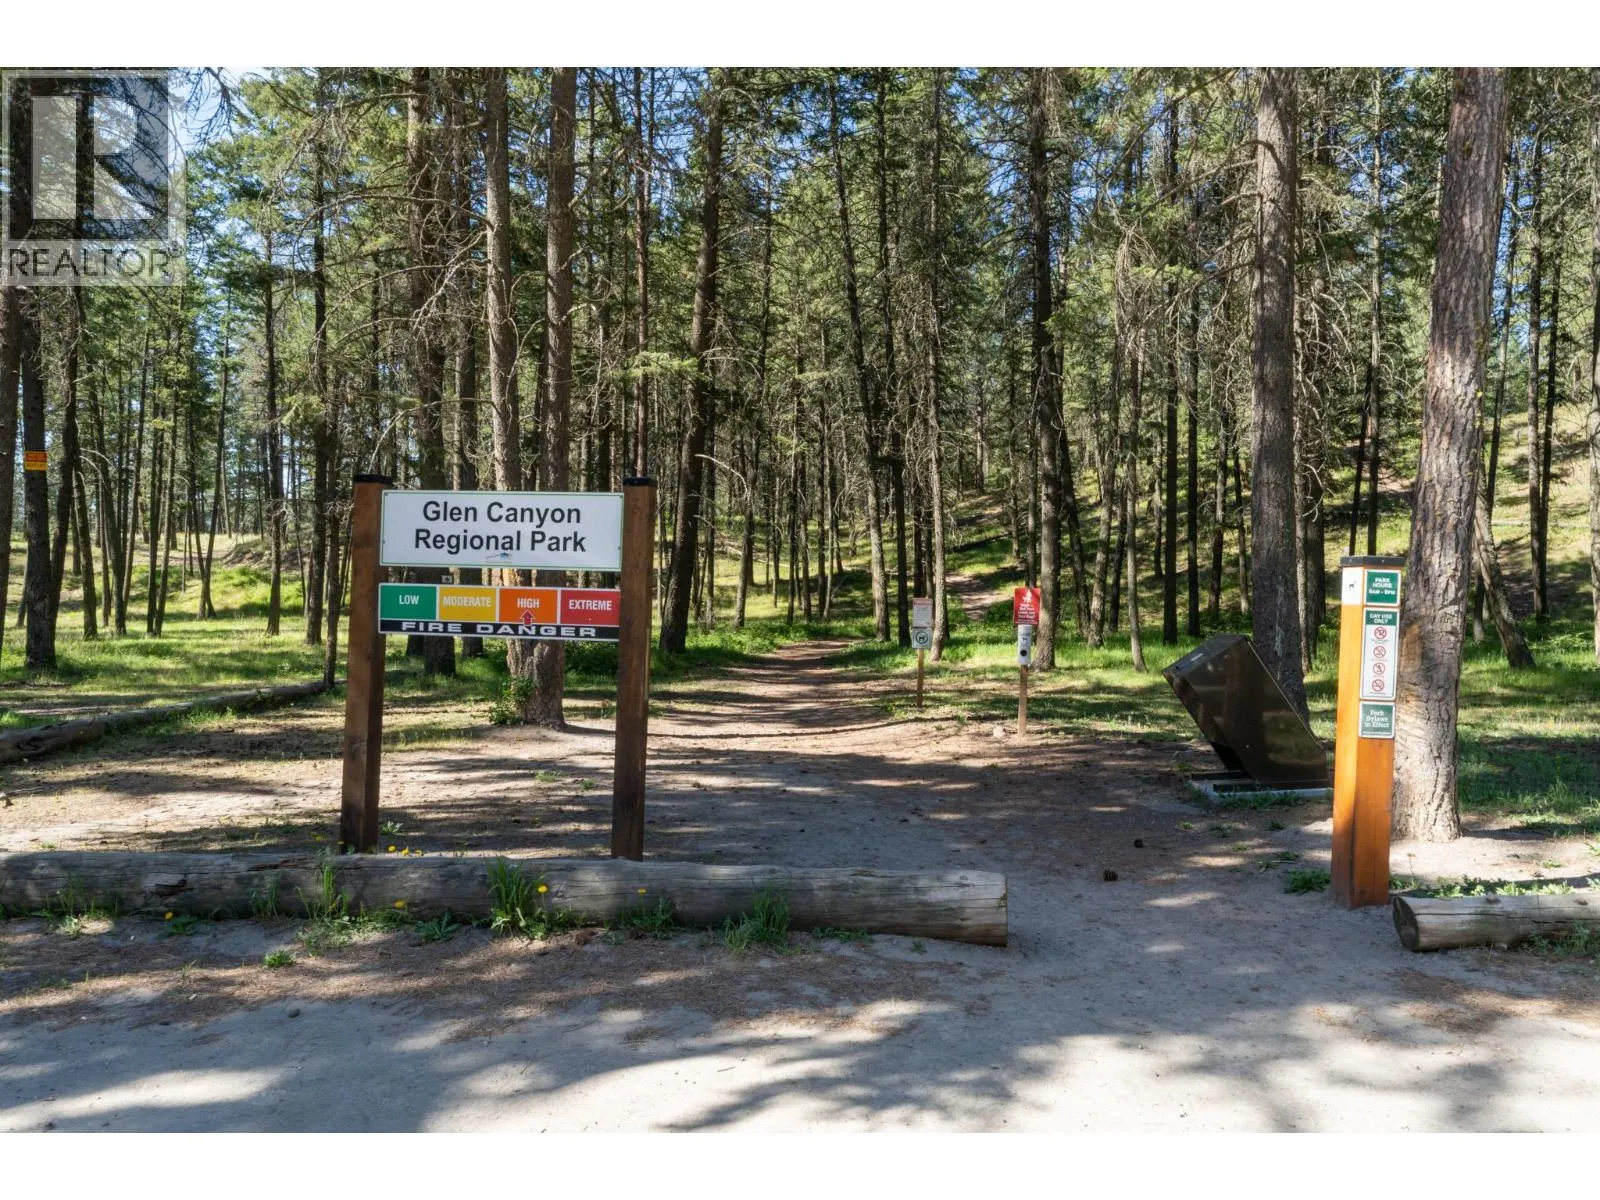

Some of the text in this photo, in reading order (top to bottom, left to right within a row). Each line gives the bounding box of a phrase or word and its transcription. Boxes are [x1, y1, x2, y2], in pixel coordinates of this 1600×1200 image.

[422, 500, 581, 529] Glen Canyon
[415, 528, 587, 555] Regional Park
[398, 594, 420, 606] LOW
[442, 595, 493, 608] MODERATE
[516, 597, 540, 609] HIGH
[568, 599, 612, 612] EXTREME
[401, 621, 597, 638] FIRE DANGER
